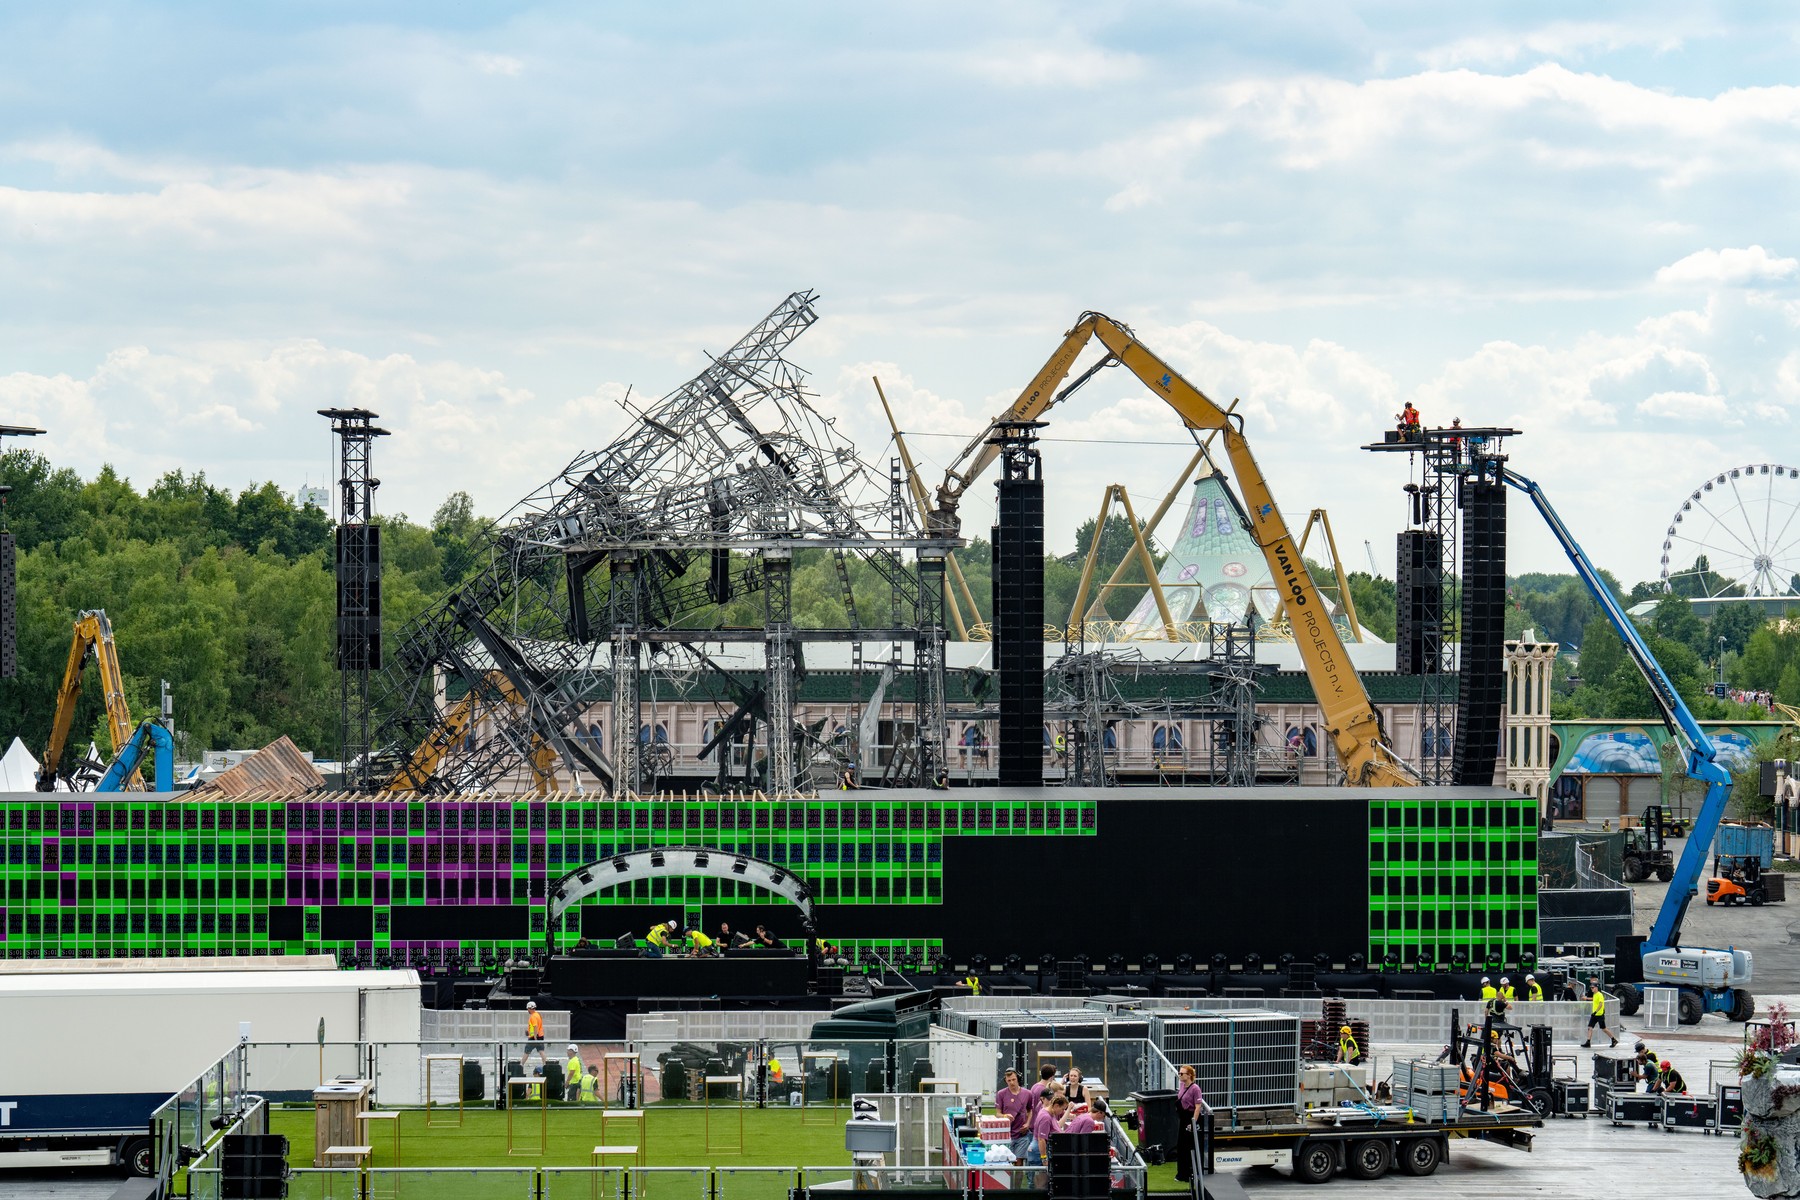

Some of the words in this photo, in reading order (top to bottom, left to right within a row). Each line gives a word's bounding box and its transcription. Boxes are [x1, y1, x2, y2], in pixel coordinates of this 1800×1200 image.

[1026, 390, 1040, 406] LOO
[1040, 358, 1065, 390] PROJECTS
[1275, 544, 1294, 576] VAN
[1288, 577, 1306, 606] LOO
[1302, 611, 1336, 673] PROJECTS
[1329, 674, 1344, 698] n.v.
[0, 1102, 17, 1126] T
